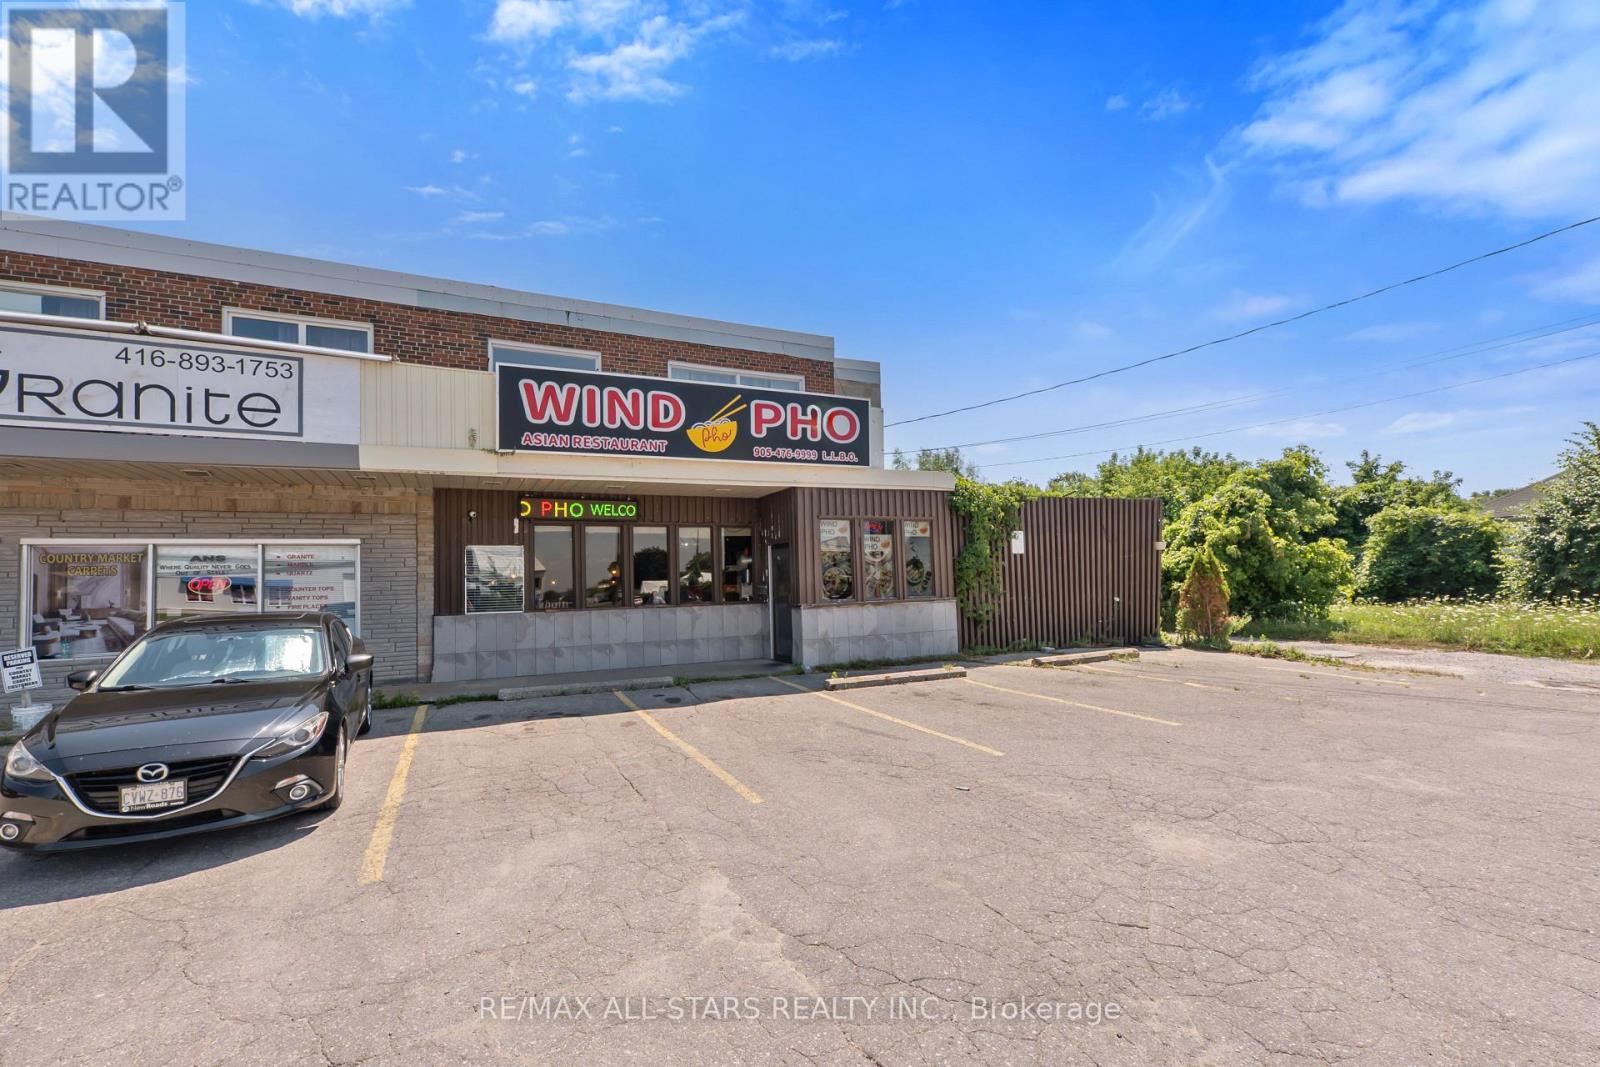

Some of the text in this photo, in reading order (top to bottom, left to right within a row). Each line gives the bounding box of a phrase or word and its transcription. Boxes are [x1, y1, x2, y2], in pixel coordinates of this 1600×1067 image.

[115, 347, 294, 379] 416-893-1753
[518, 378, 686, 432] WIND
[751, 400, 861, 444] PHO
[521, 432, 668, 452] ASIAN RESTAURANT
[753, 446, 818, 460] 905-476-9999
[541, 501, 584, 518] PHO
[590, 503, 636, 517] WELCO
[39, 552, 144, 564] COUNTRY MARKET
[67, 565, 119, 577] CARPETS
[161, 785, 184, 800] 876
